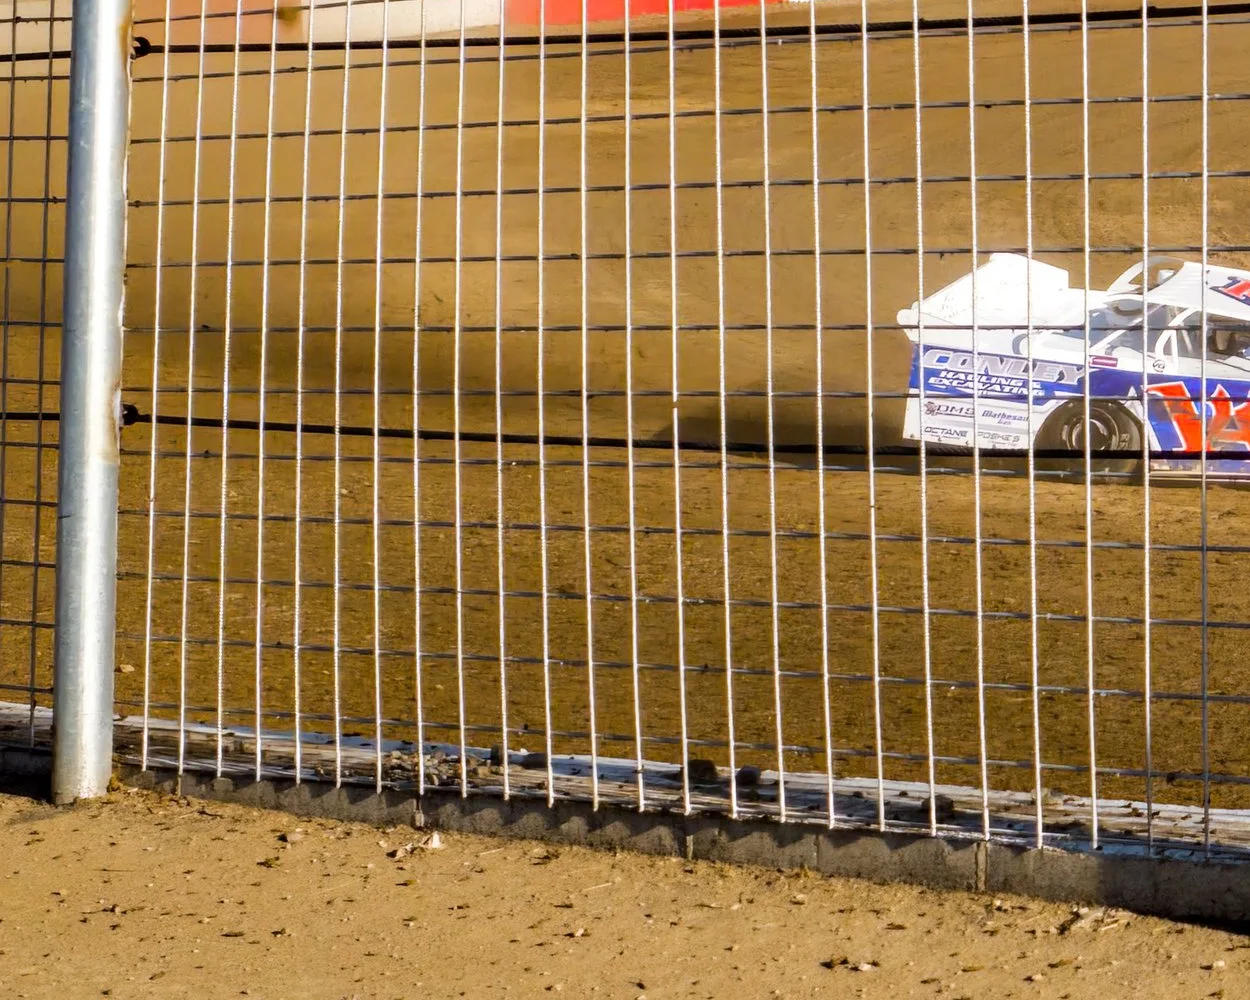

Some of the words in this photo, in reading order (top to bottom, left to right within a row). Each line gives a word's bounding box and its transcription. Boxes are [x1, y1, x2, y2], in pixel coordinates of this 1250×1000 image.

[923, 348, 1086, 385] CONLEY
[928, 376, 1046, 396] EXCAVATING
[939, 370, 1024, 386] HAULING
[924, 426, 968, 437] OCTANE
